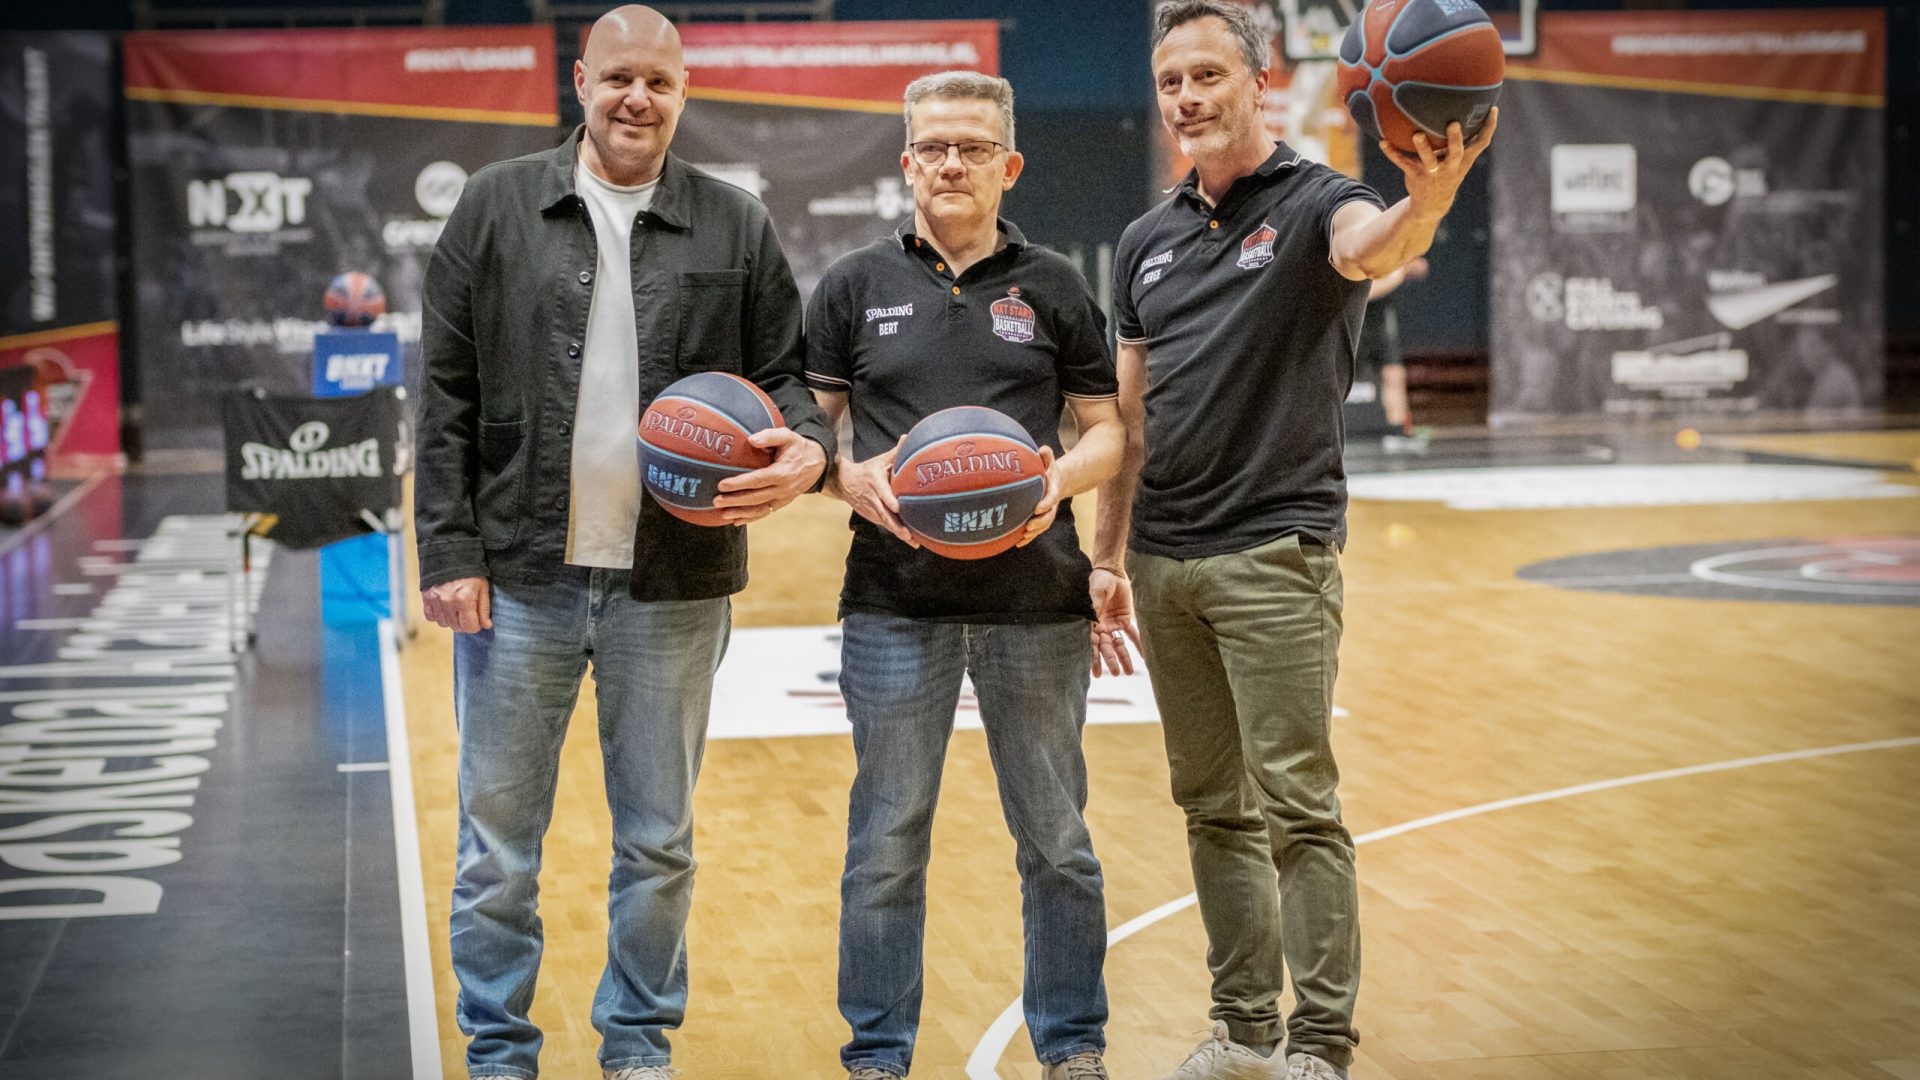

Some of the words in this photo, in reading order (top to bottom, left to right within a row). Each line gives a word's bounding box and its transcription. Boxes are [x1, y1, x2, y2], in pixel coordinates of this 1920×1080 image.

[865, 303, 913, 322] SPALDING
[993, 302, 1009, 316] NXT
[1009, 304, 1033, 321] STARS
[995, 317, 1033, 336] BASKETBALL
[879, 321, 899, 337] BERT
[642, 410, 735, 459] SPALDING
[241, 437, 384, 480] SPALDING
[915, 449, 1023, 488] SPALDING
[647, 463, 703, 498] BNXT
[943, 503, 1009, 533] BNXT
